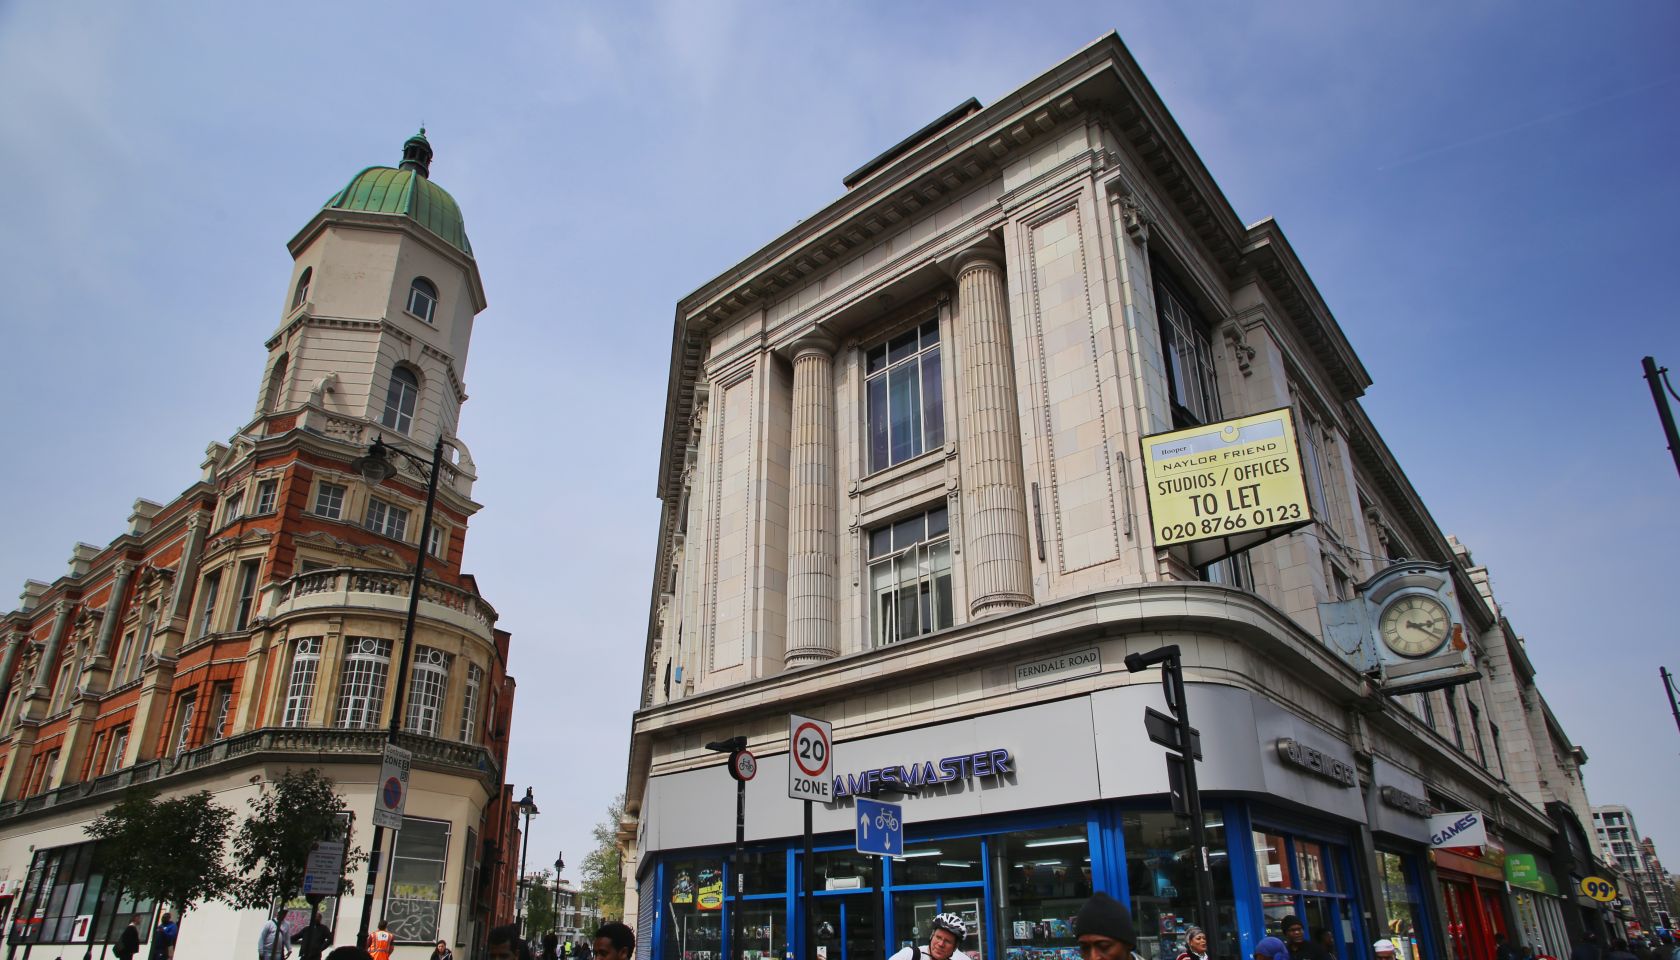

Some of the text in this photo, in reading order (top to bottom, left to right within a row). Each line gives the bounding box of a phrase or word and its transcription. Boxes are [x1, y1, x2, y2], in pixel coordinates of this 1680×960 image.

[1161, 446, 1187, 456] Hooper
[1163, 443, 1277, 471] NAYLOR FRIEND
[1158, 472, 1216, 496] STUDIOS
[1234, 458, 1290, 482] OFFICES
[1188, 483, 1261, 517] TO LET
[1161, 503, 1301, 541] 020 8766 0123
[1018, 652, 1097, 678] FERNDALE ROAD
[384, 754, 402, 769] ZONE
[799, 737, 825, 762] 20
[794, 778, 828, 796] ZONE
[1431, 813, 1478, 846] GAMES
